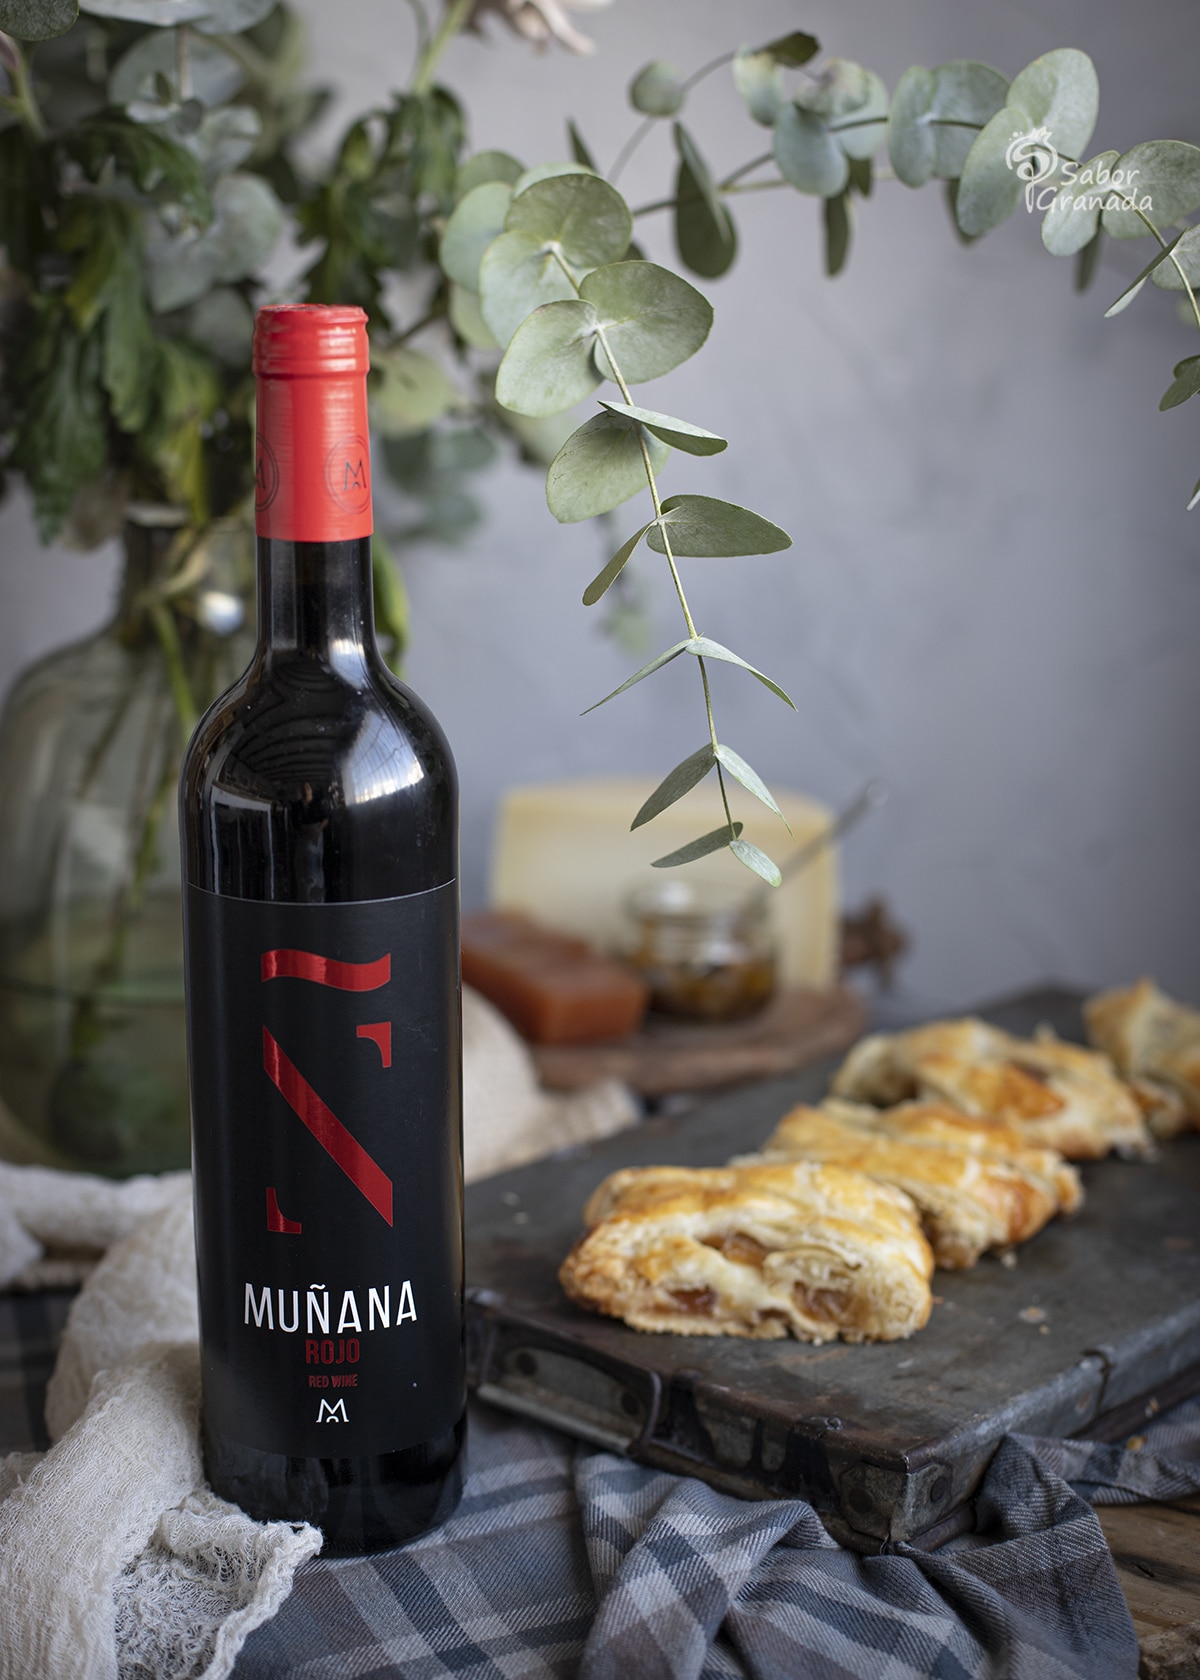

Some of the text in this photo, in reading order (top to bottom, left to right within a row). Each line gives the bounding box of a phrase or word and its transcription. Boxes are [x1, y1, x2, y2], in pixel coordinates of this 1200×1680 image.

[244, 1280, 418, 1335] MUÑANA
[305, 1338, 360, 1365] ROJO
[308, 1373, 359, 1388] RED WINE
